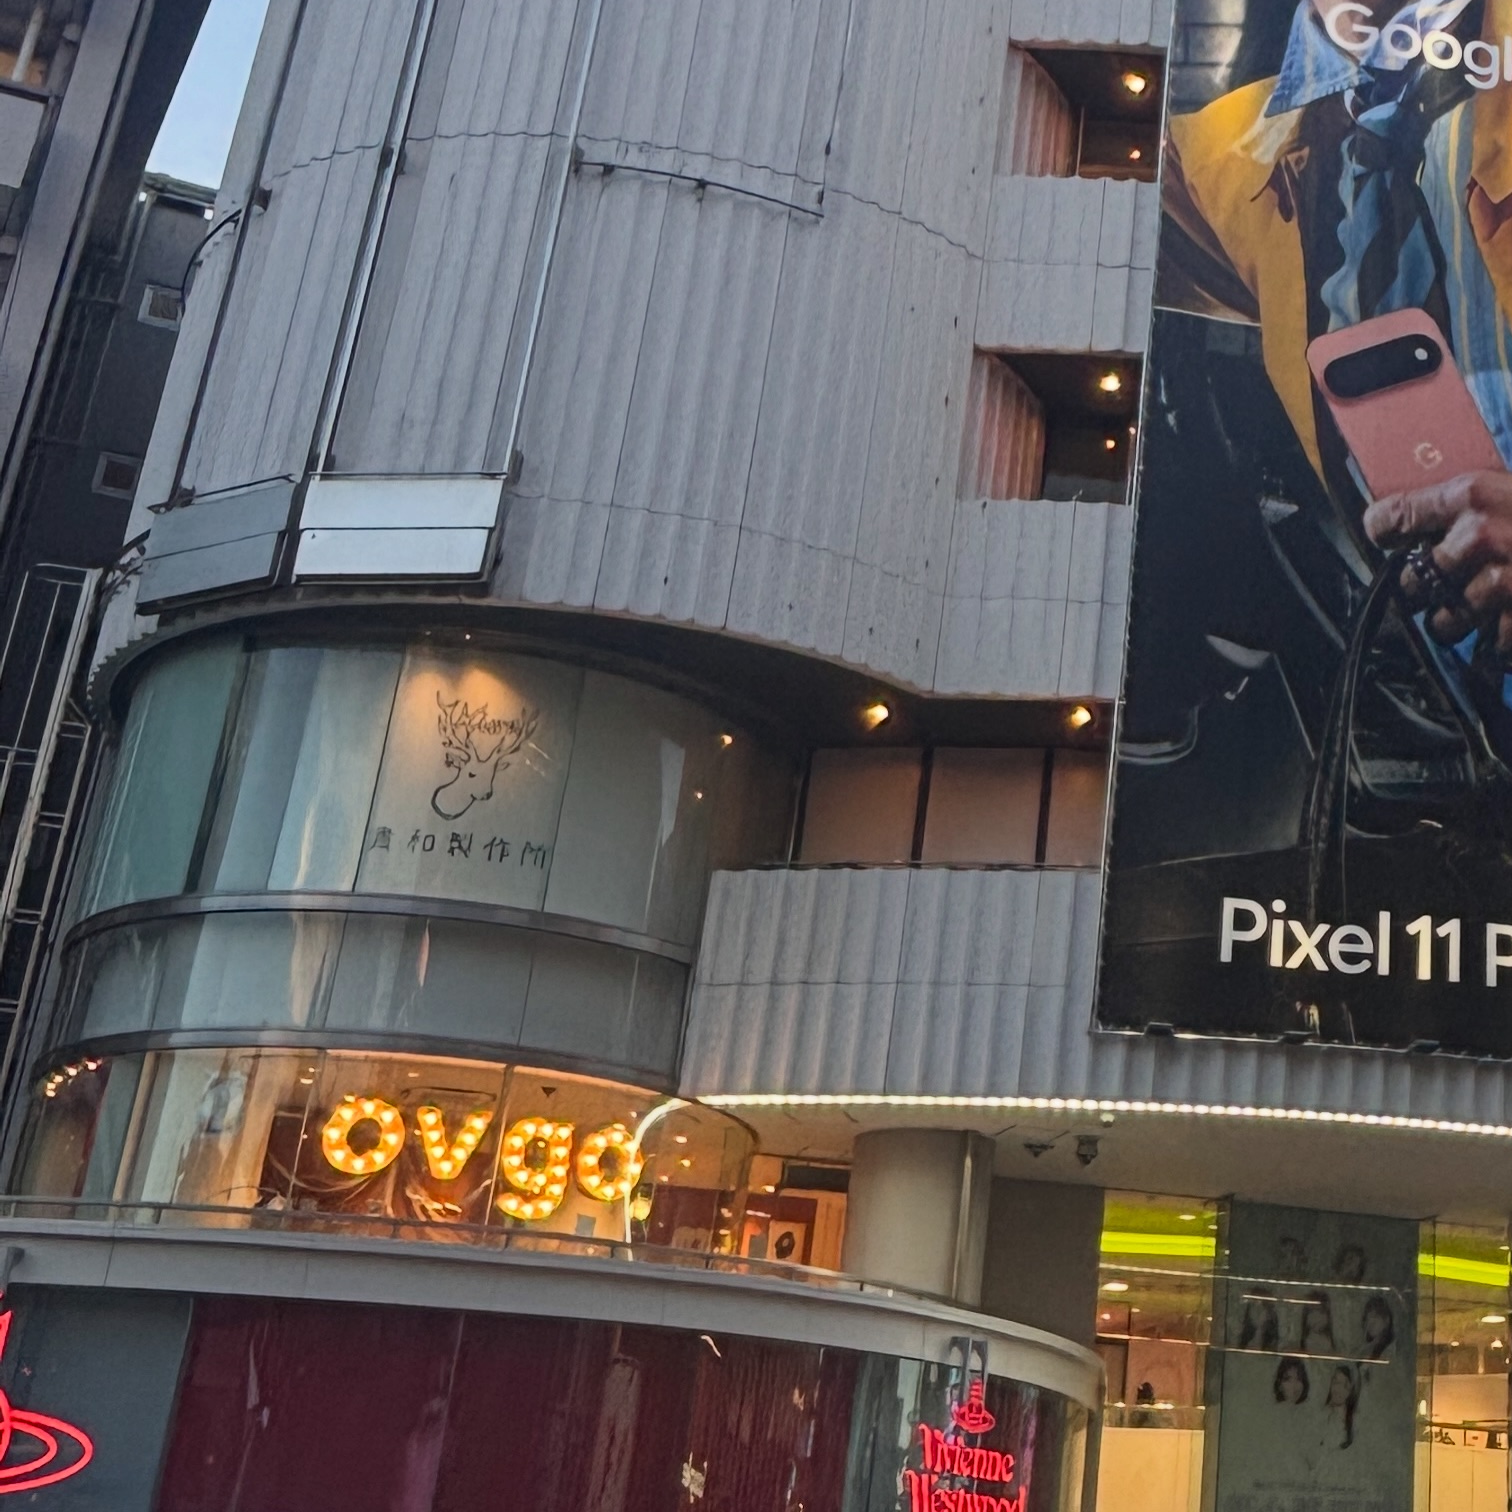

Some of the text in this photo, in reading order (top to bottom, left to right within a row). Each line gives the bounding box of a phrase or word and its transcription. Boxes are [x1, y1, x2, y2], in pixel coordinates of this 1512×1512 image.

[1220, 897, 1389, 976] Pixel
[1406, 915, 1461, 983] 11
[322, 1094, 644, 1220] ovgo
[918, 1423, 1015, 1482] Vivienne
